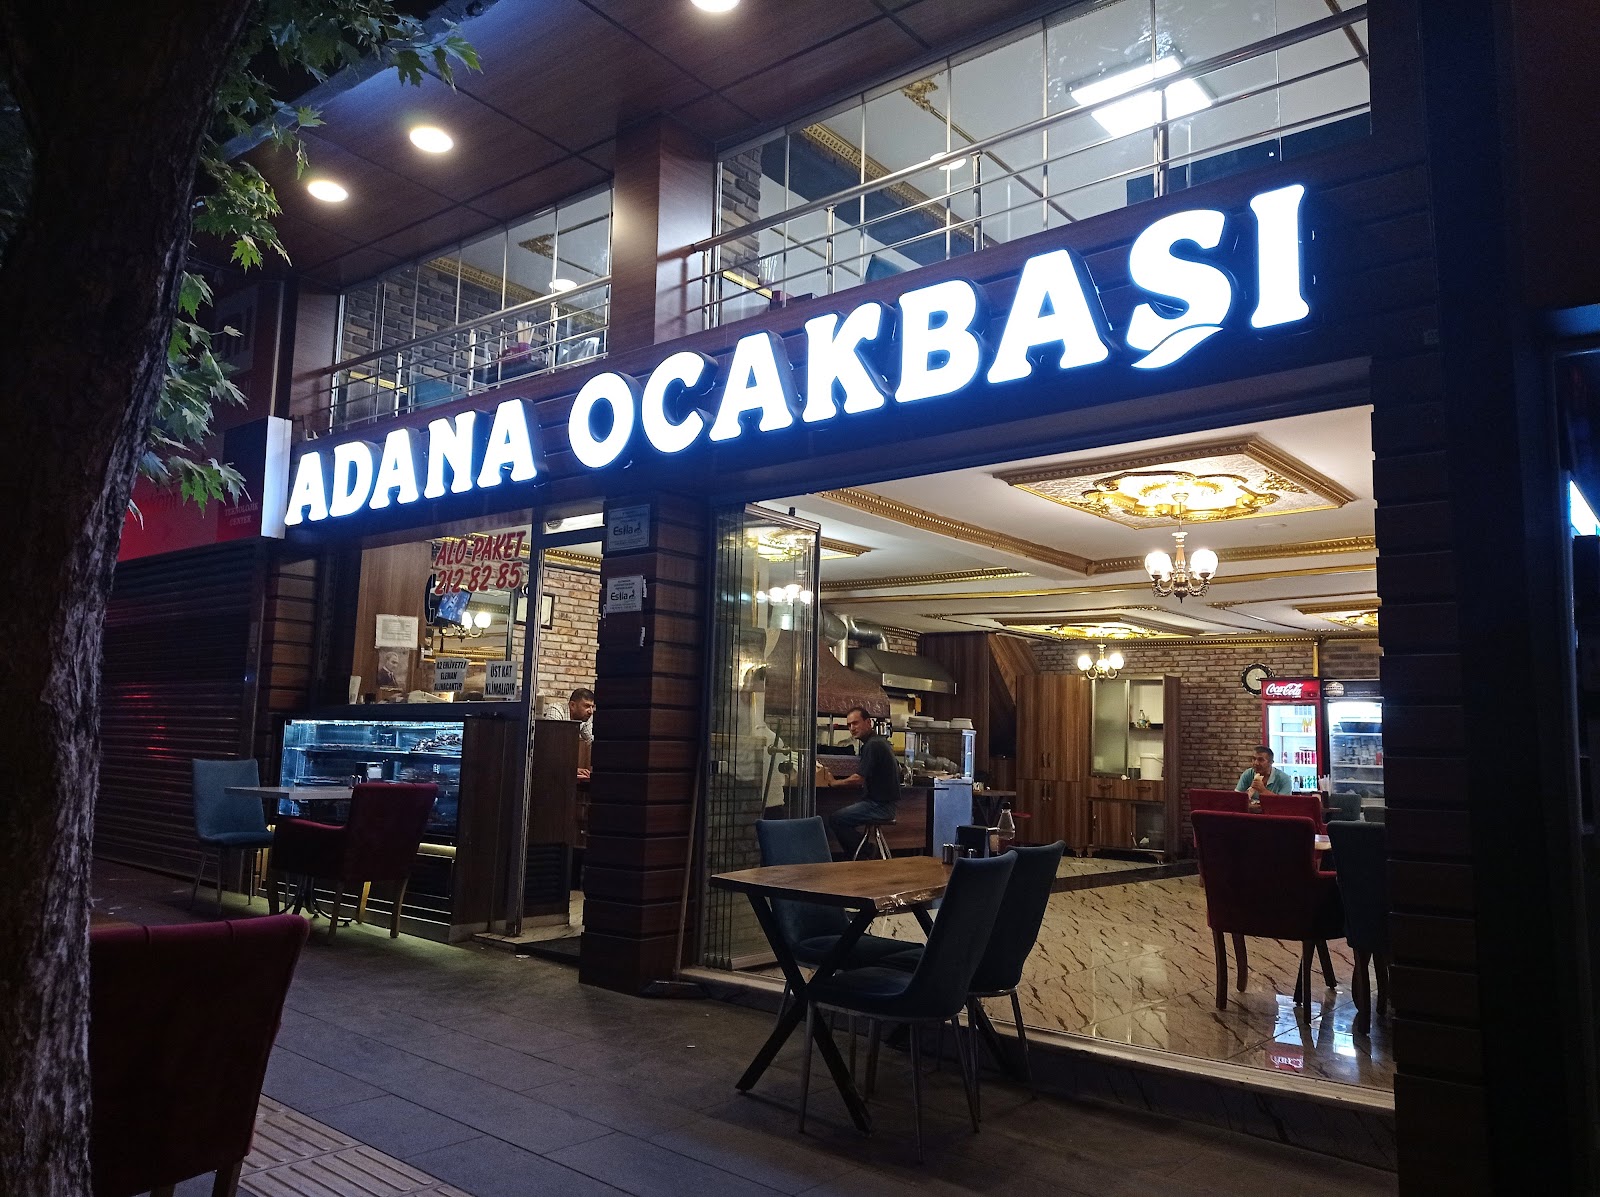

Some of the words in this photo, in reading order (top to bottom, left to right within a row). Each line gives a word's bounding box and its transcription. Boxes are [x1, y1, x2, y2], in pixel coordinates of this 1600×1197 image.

[284, 398, 537, 526] ADANA
[435, 539, 467, 566] ALO
[472, 531, 526, 561] PAKET
[435, 568, 464, 595] 212
[468, 565, 492, 592] 82
[496, 562, 522, 589] 85
[490, 664, 501, 678] ÜST
[502, 665, 512, 678] KAT
[1265, 683, 1304, 697] Coca-Cola
